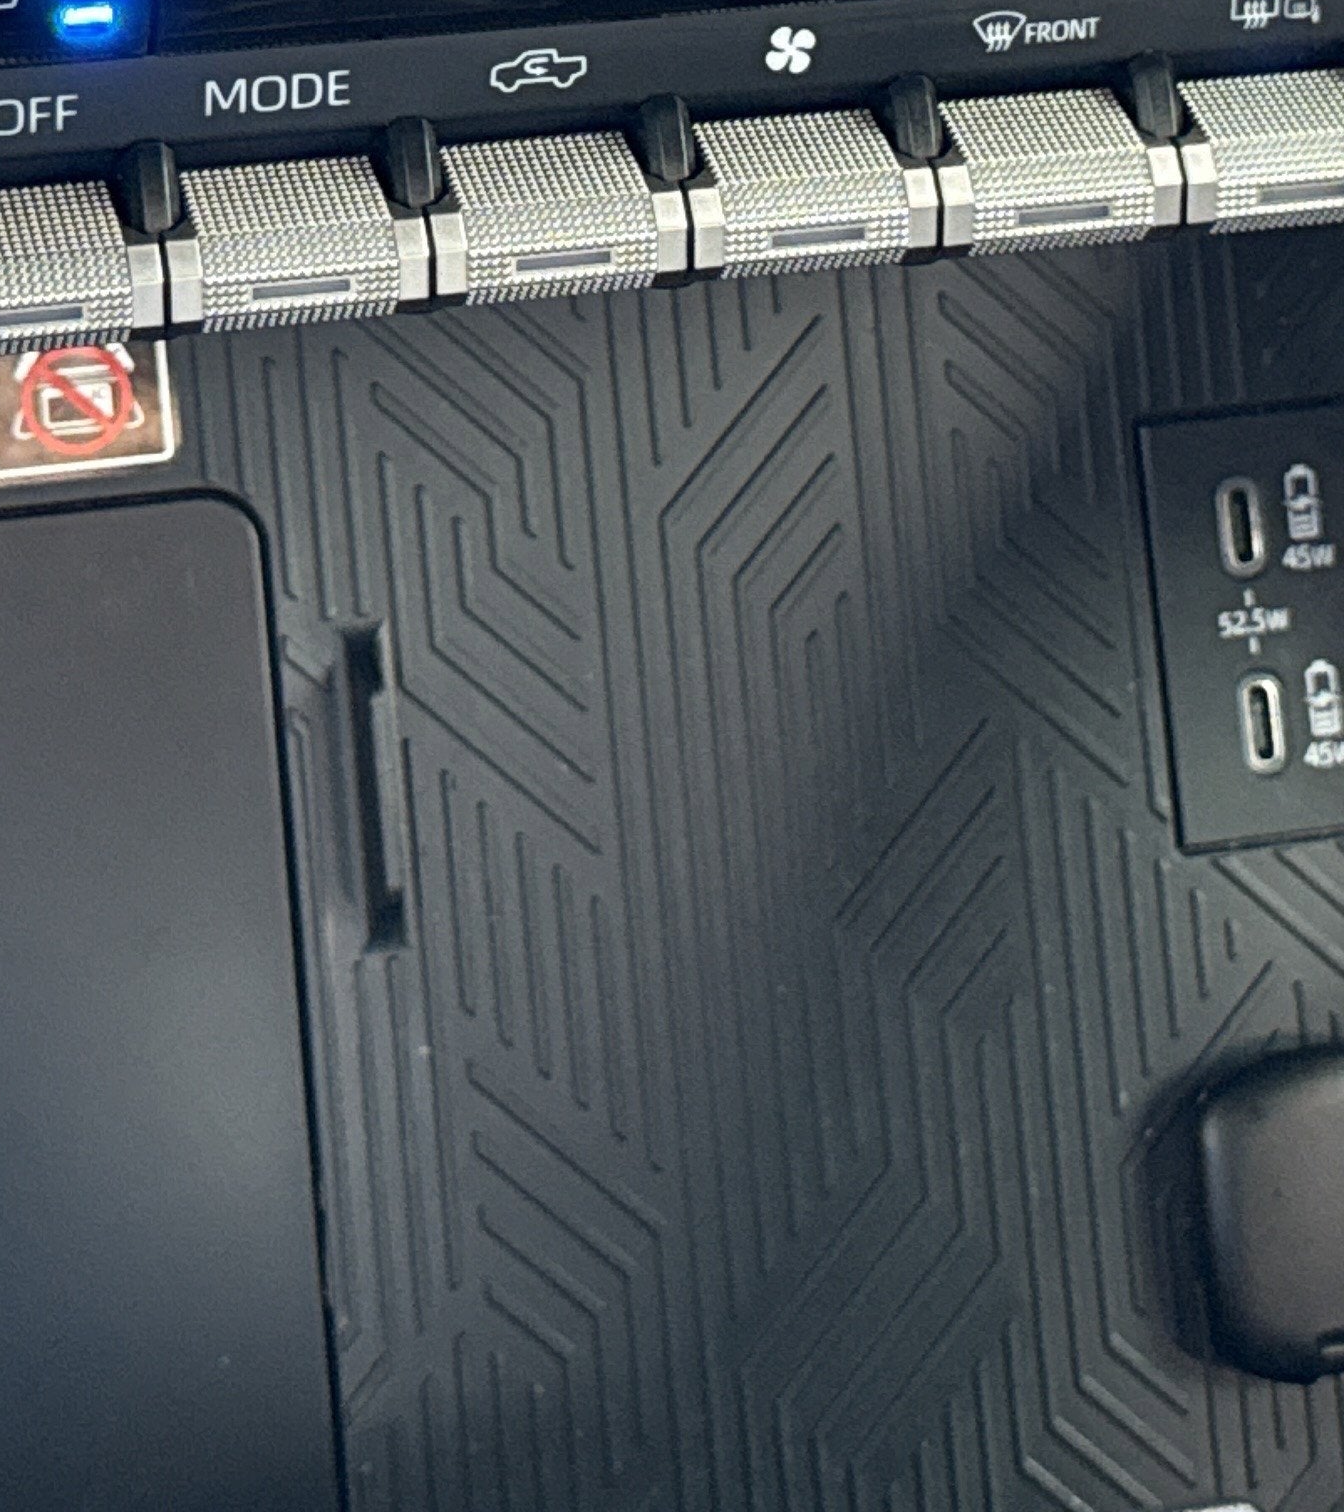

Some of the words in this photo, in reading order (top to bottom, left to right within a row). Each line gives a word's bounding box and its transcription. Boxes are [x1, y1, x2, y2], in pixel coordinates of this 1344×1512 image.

[1024, 16, 1100, 42] FRONT
[204, 69, 352, 118] MODE
[1281, 543, 1337, 570] 45W
[1217, 608, 1292, 638] 52.5W
